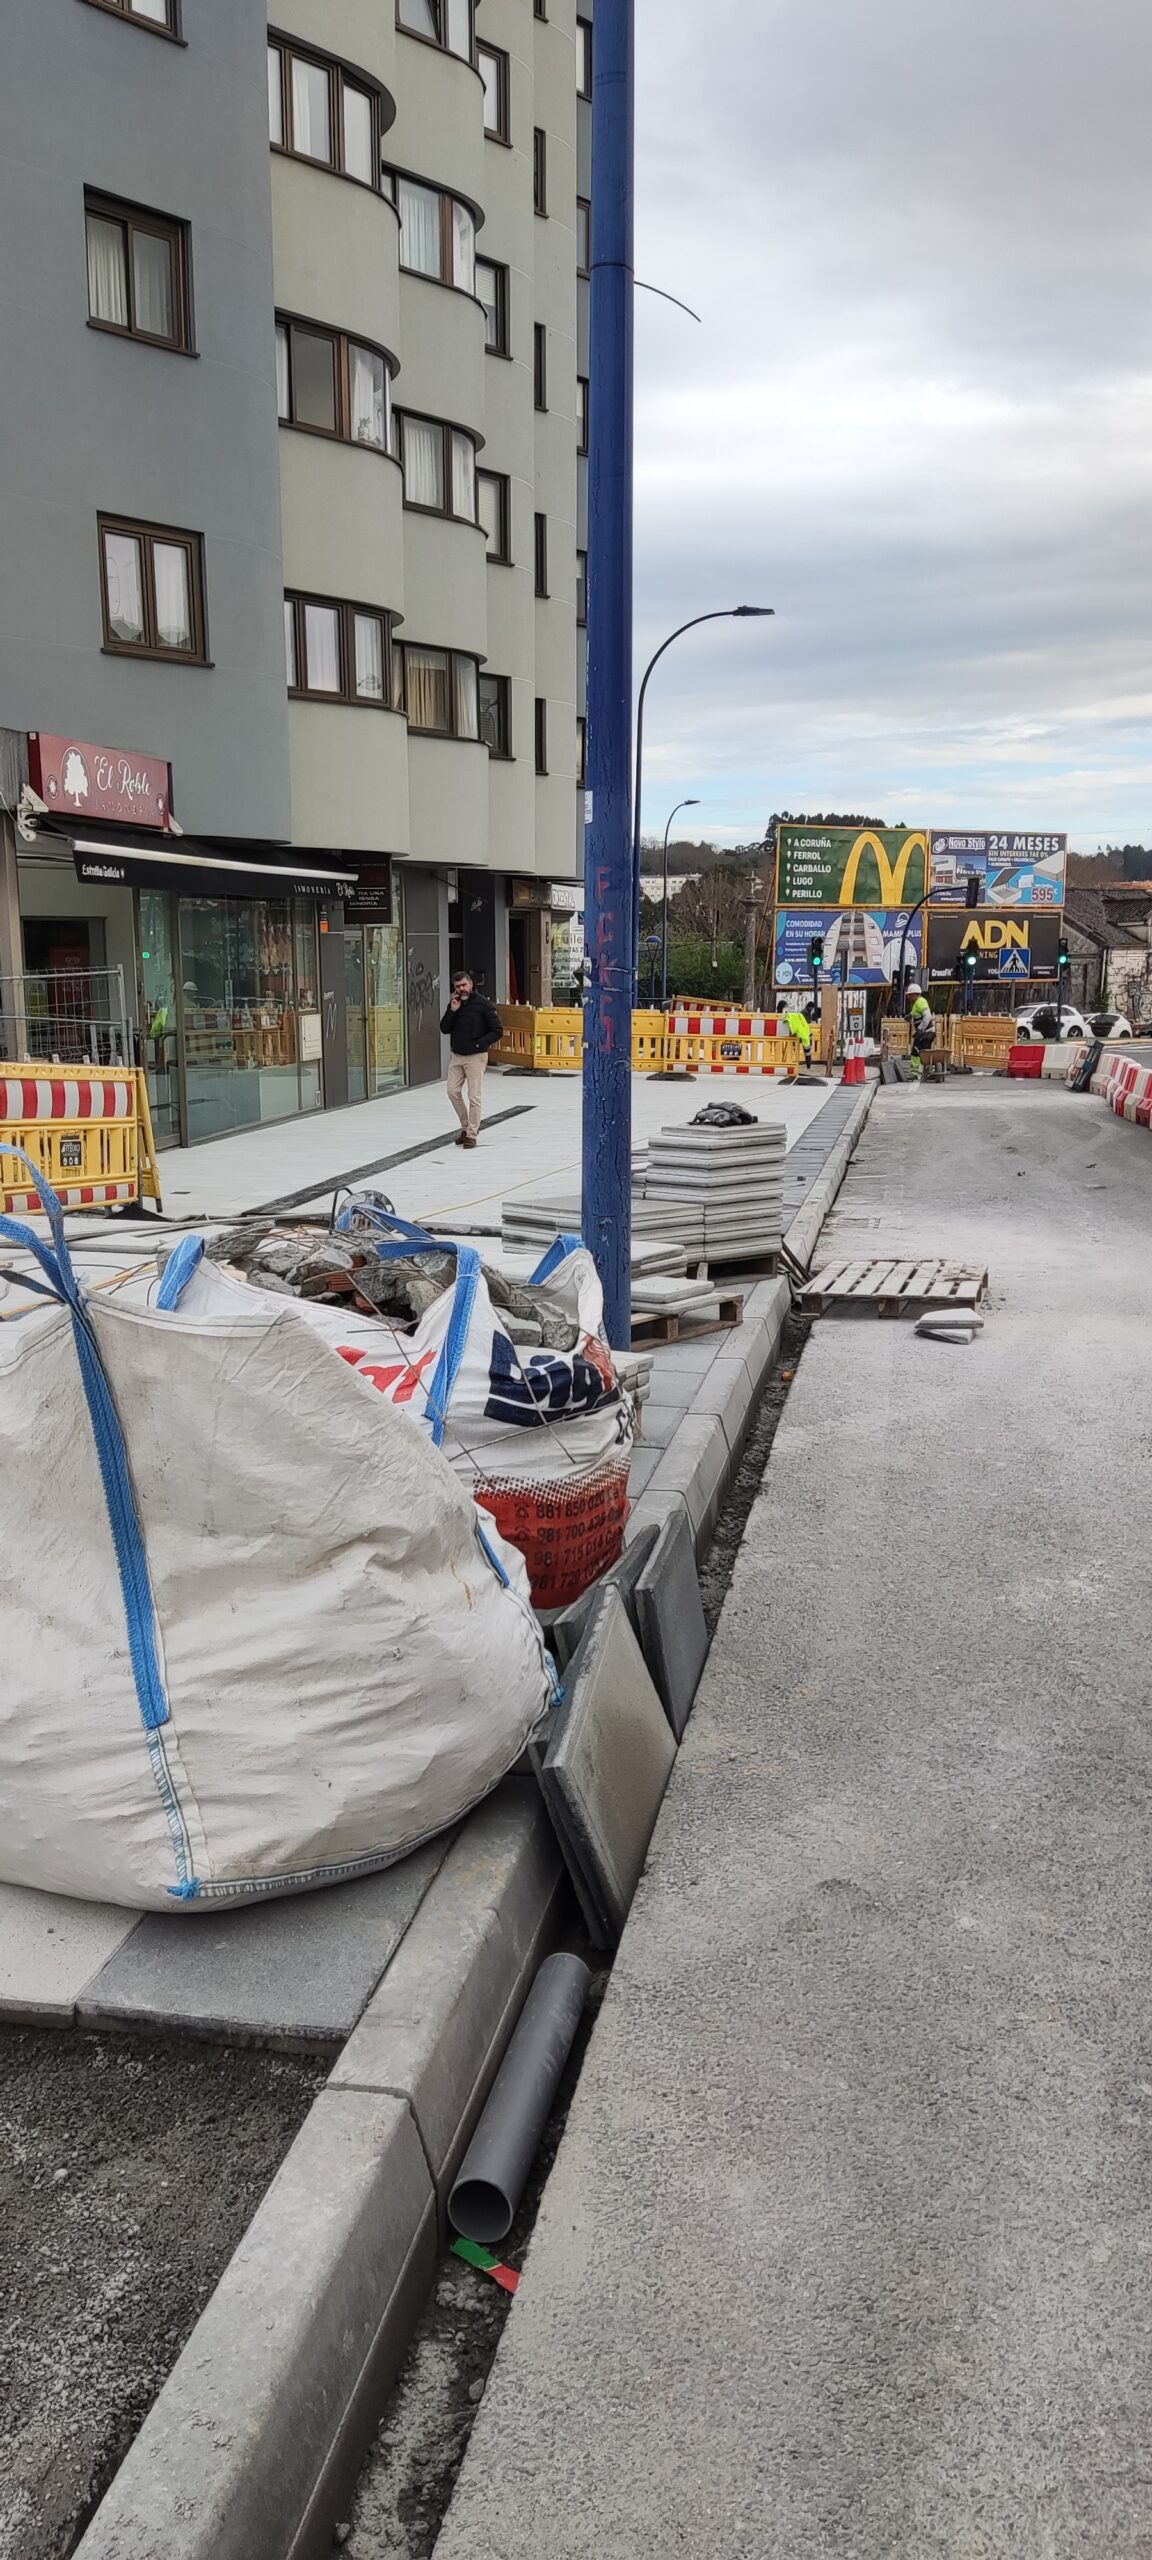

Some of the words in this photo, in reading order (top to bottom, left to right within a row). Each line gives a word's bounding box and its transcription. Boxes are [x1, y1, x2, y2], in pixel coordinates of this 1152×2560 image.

[94, 755, 113, 791] El
[117, 759, 150, 801] Roble
[793, 839, 799, 847] A
[801, 836, 831, 848] CORUÑA
[989, 835, 1008, 850] 24
[1013, 836, 1059, 851] MESES
[794, 851, 821, 860] FERROL
[793, 864, 831, 873] CARBALLO
[793, 877, 813, 885] LUGO
[792, 890, 822, 898] PERILLO
[786, 920, 822, 928] COMODIDAD
[804, 930, 825, 938] HOGAR
[960, 920, 1029, 950] ADN
